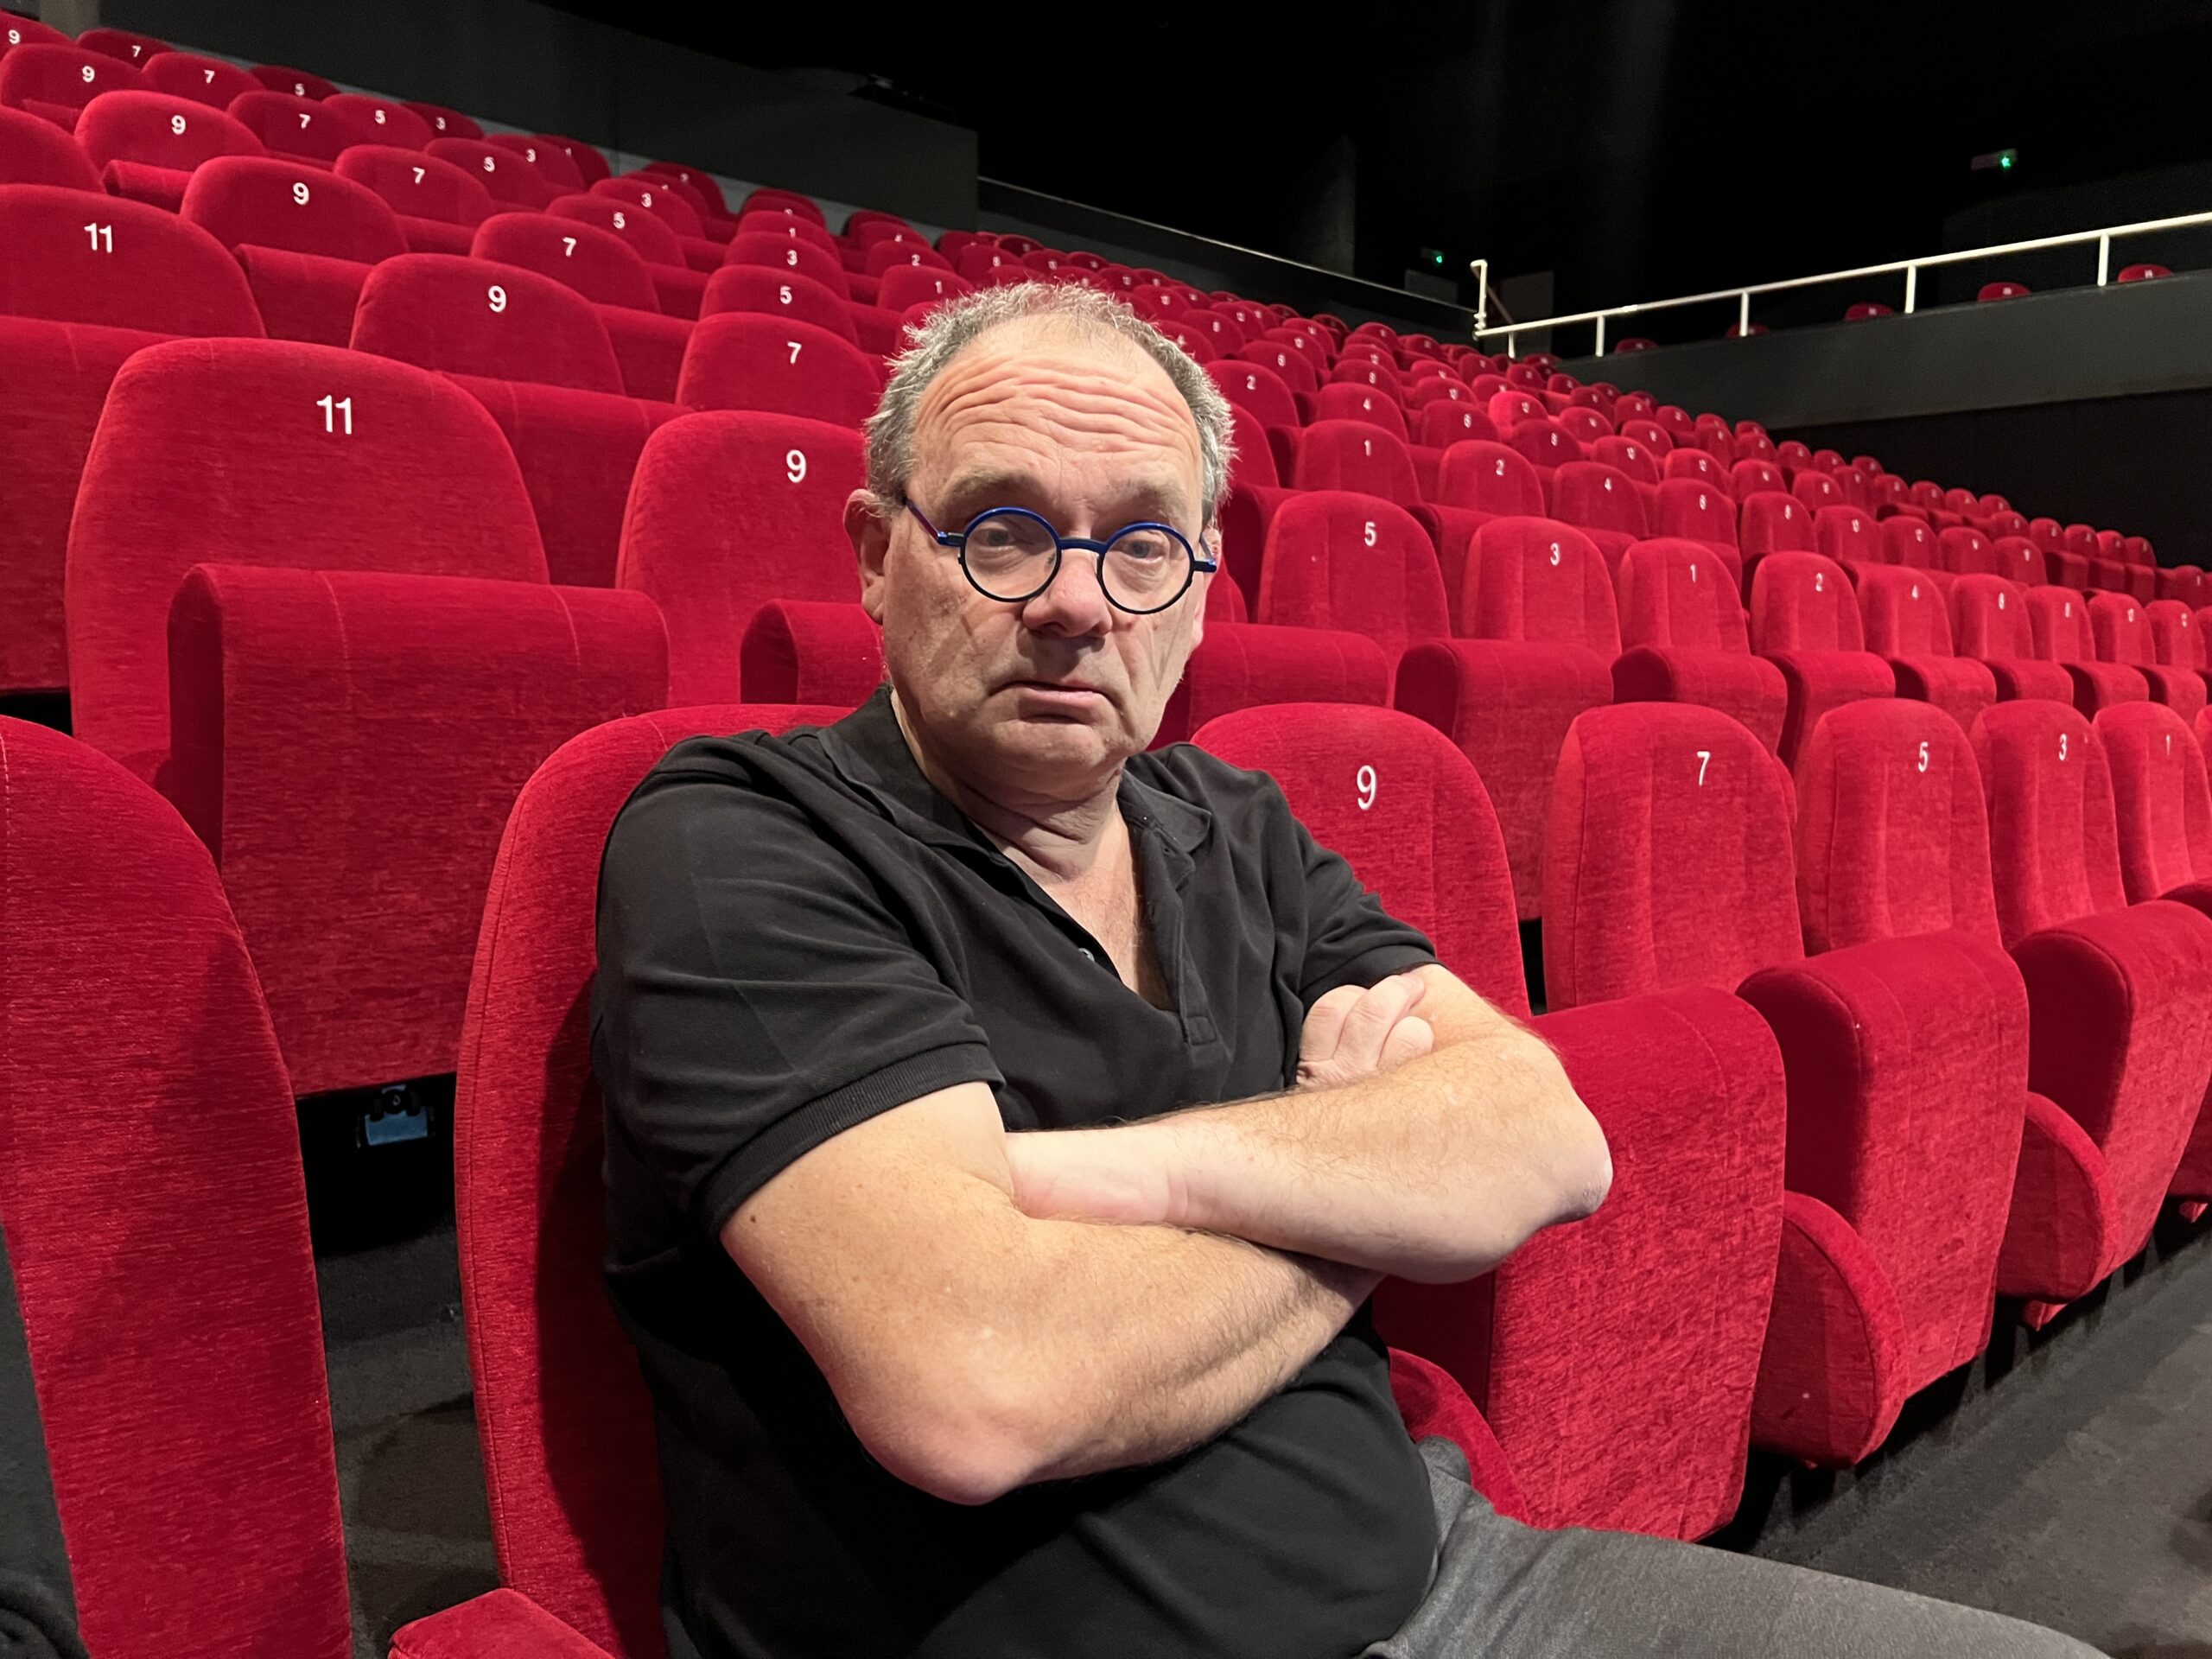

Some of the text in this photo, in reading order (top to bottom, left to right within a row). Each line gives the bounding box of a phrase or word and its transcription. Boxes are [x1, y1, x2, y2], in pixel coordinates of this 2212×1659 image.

[8, 29, 21, 45] 9
[131, 45, 142, 57] 7
[81, 65, 96, 83] 9
[204, 69, 215, 84] 7
[295, 83, 305, 97] 5
[171, 115, 187, 135] 9
[299, 113, 311, 129] 7
[375, 110, 386, 124] 5
[436, 117, 446, 130] 3
[526, 149, 536, 162] 3
[483, 156, 495, 173] 5
[412, 167, 425, 184] 7
[292, 181, 310, 206] 9
[642, 193, 652, 208] 3
[613, 212, 626, 229] 5
[84, 223, 112, 253] 11
[563, 237, 577, 257] 7
[787, 250, 798, 266] 3
[912, 254, 920, 267] 2
[779, 285, 792, 305] 5
[935, 281, 942, 294] 1
[487, 285, 507, 313] 9
[787, 341, 802, 365] 7
[1247, 375, 1255, 391] 2
[1363, 399, 1371, 410] 4
[317, 395, 352, 435] 11
[1363, 440, 1371, 455] 1
[785, 449, 807, 484] 9
[1496, 459, 1504, 476] 2
[1604, 478, 1612, 491] 4
[1363, 521, 1377, 547] 5
[1549, 542, 1560, 566] 3
[1690, 564, 1696, 583] 1
[1815, 573, 1823, 592] 2
[2058, 733, 2068, 761] 3
[1917, 741, 1929, 773] 5
[1696, 750, 1711, 786] 7
[1356, 765, 1377, 810] 9
